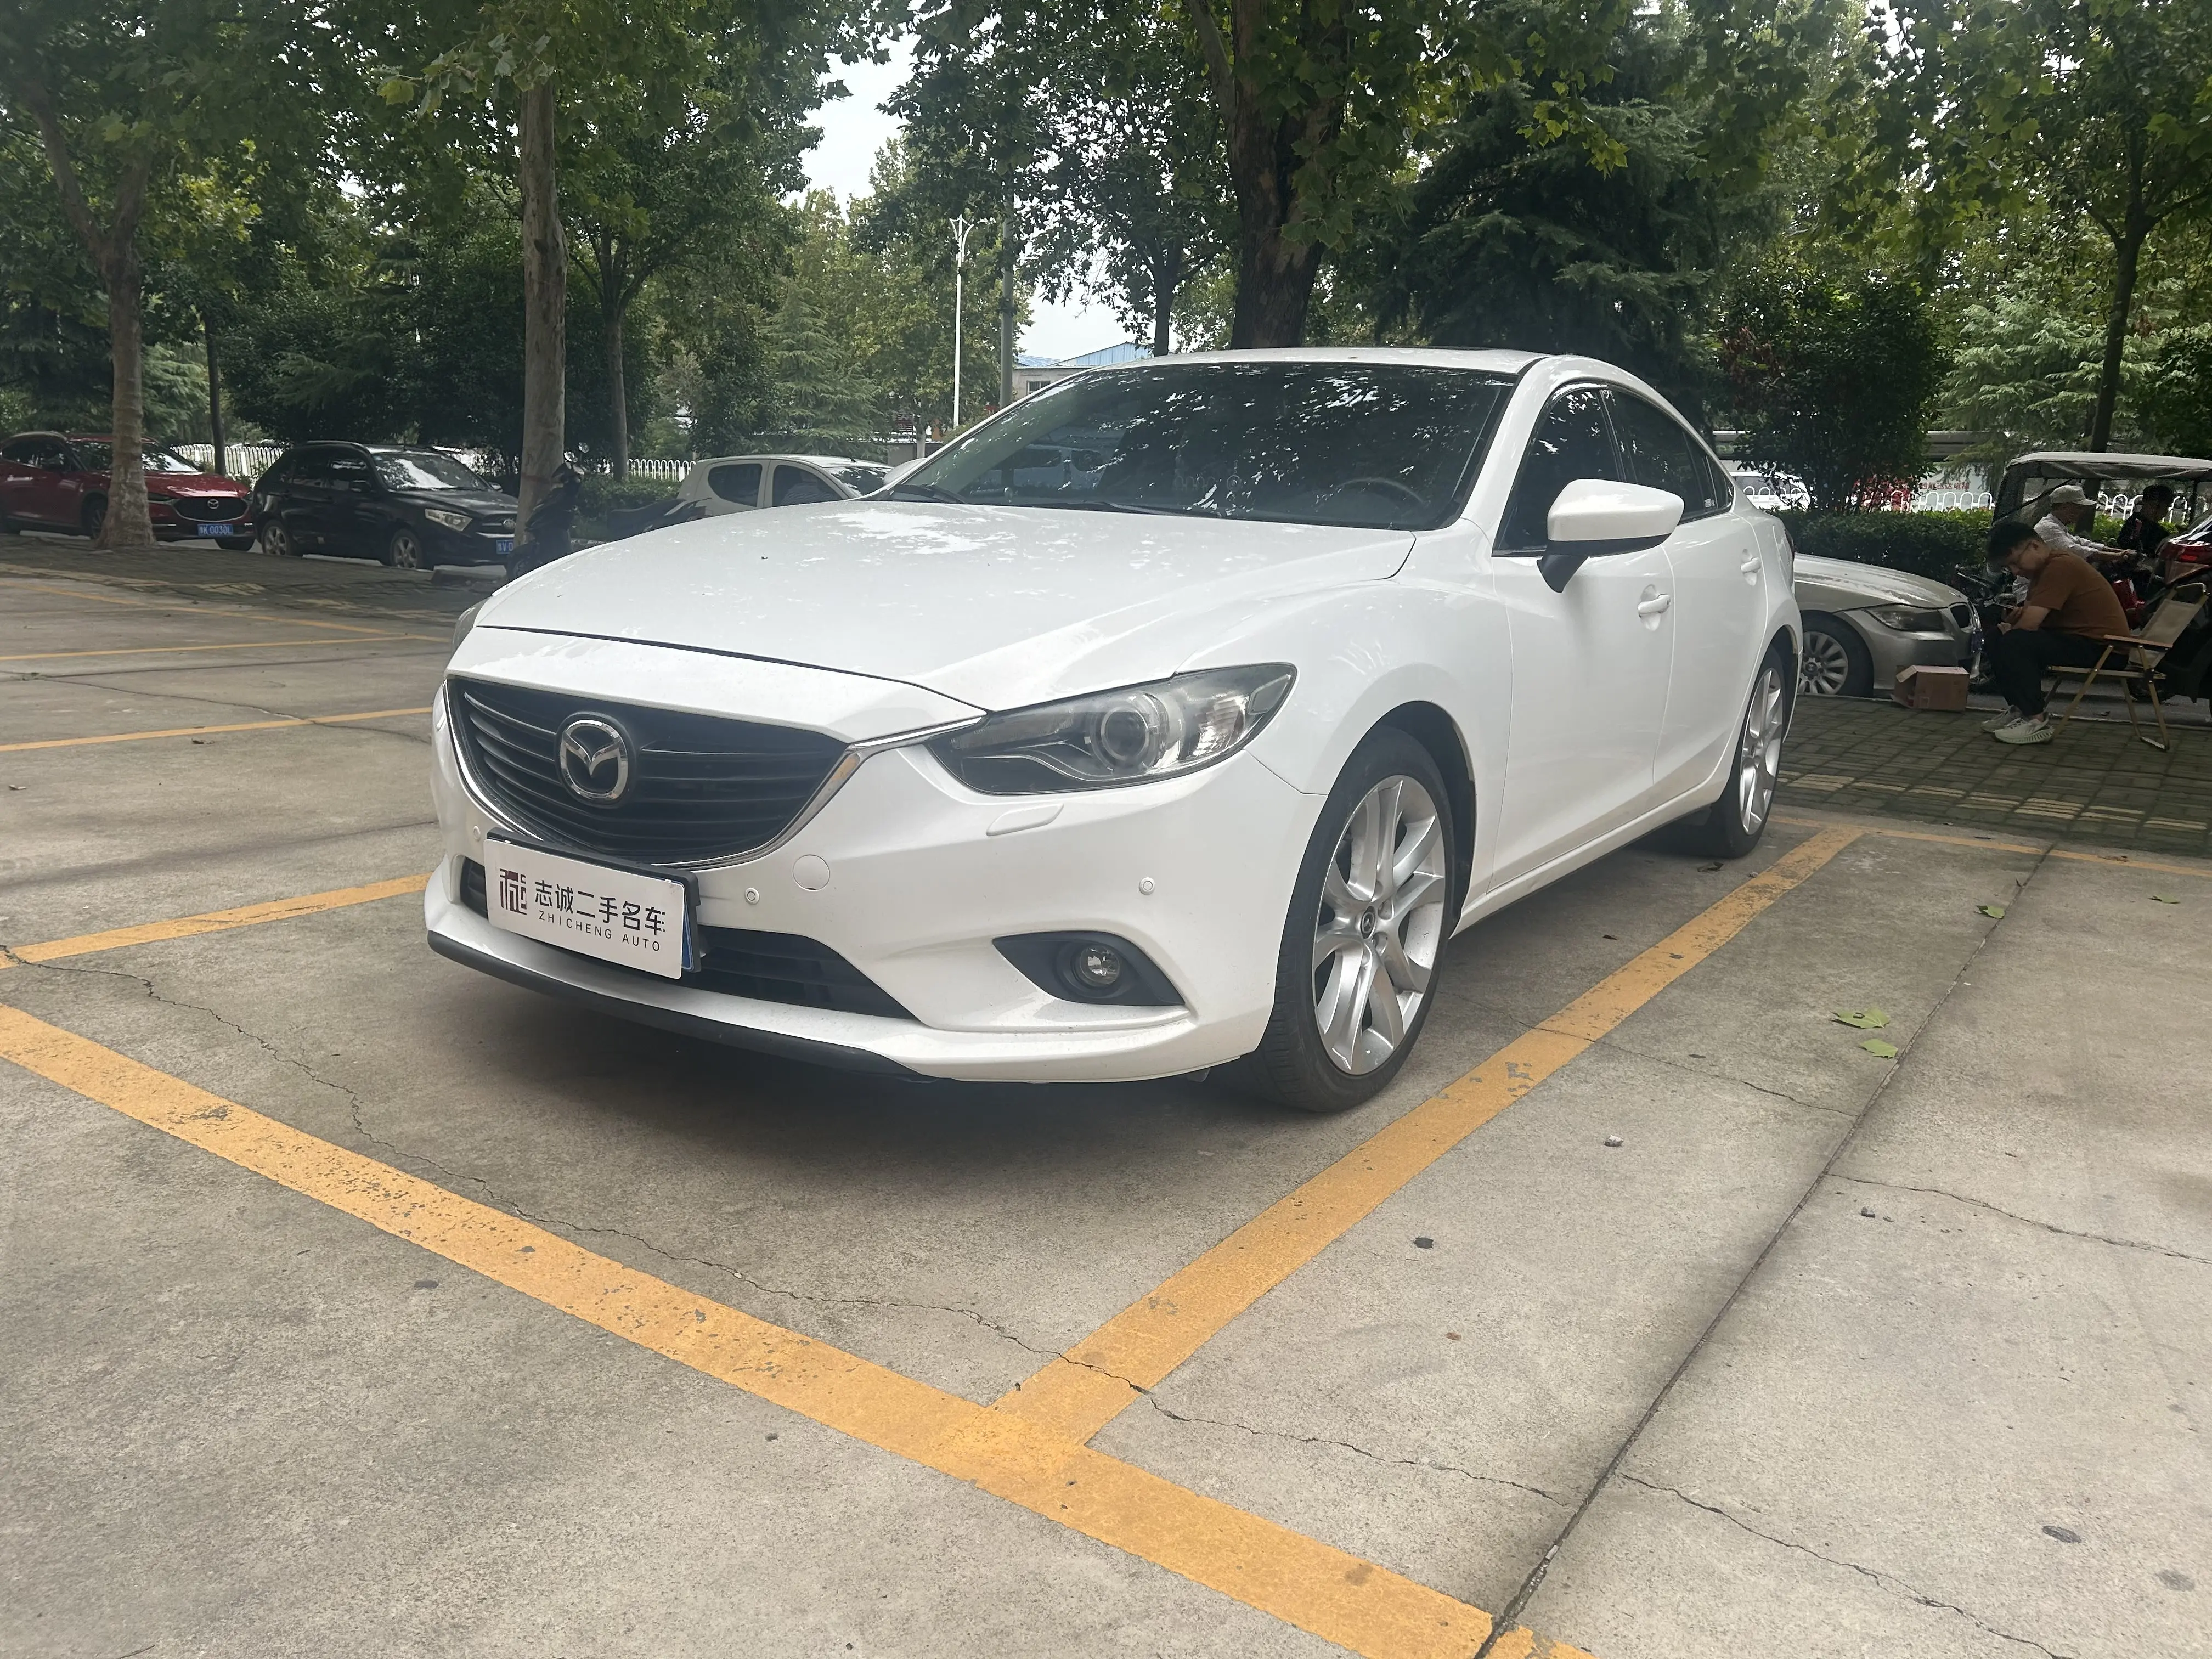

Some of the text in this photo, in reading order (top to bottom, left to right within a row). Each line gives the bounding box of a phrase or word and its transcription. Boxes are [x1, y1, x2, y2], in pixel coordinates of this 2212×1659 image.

[534, 879, 665, 936] 志诚二手名车
[539, 910, 660, 952] ZHICHENG AUTO
